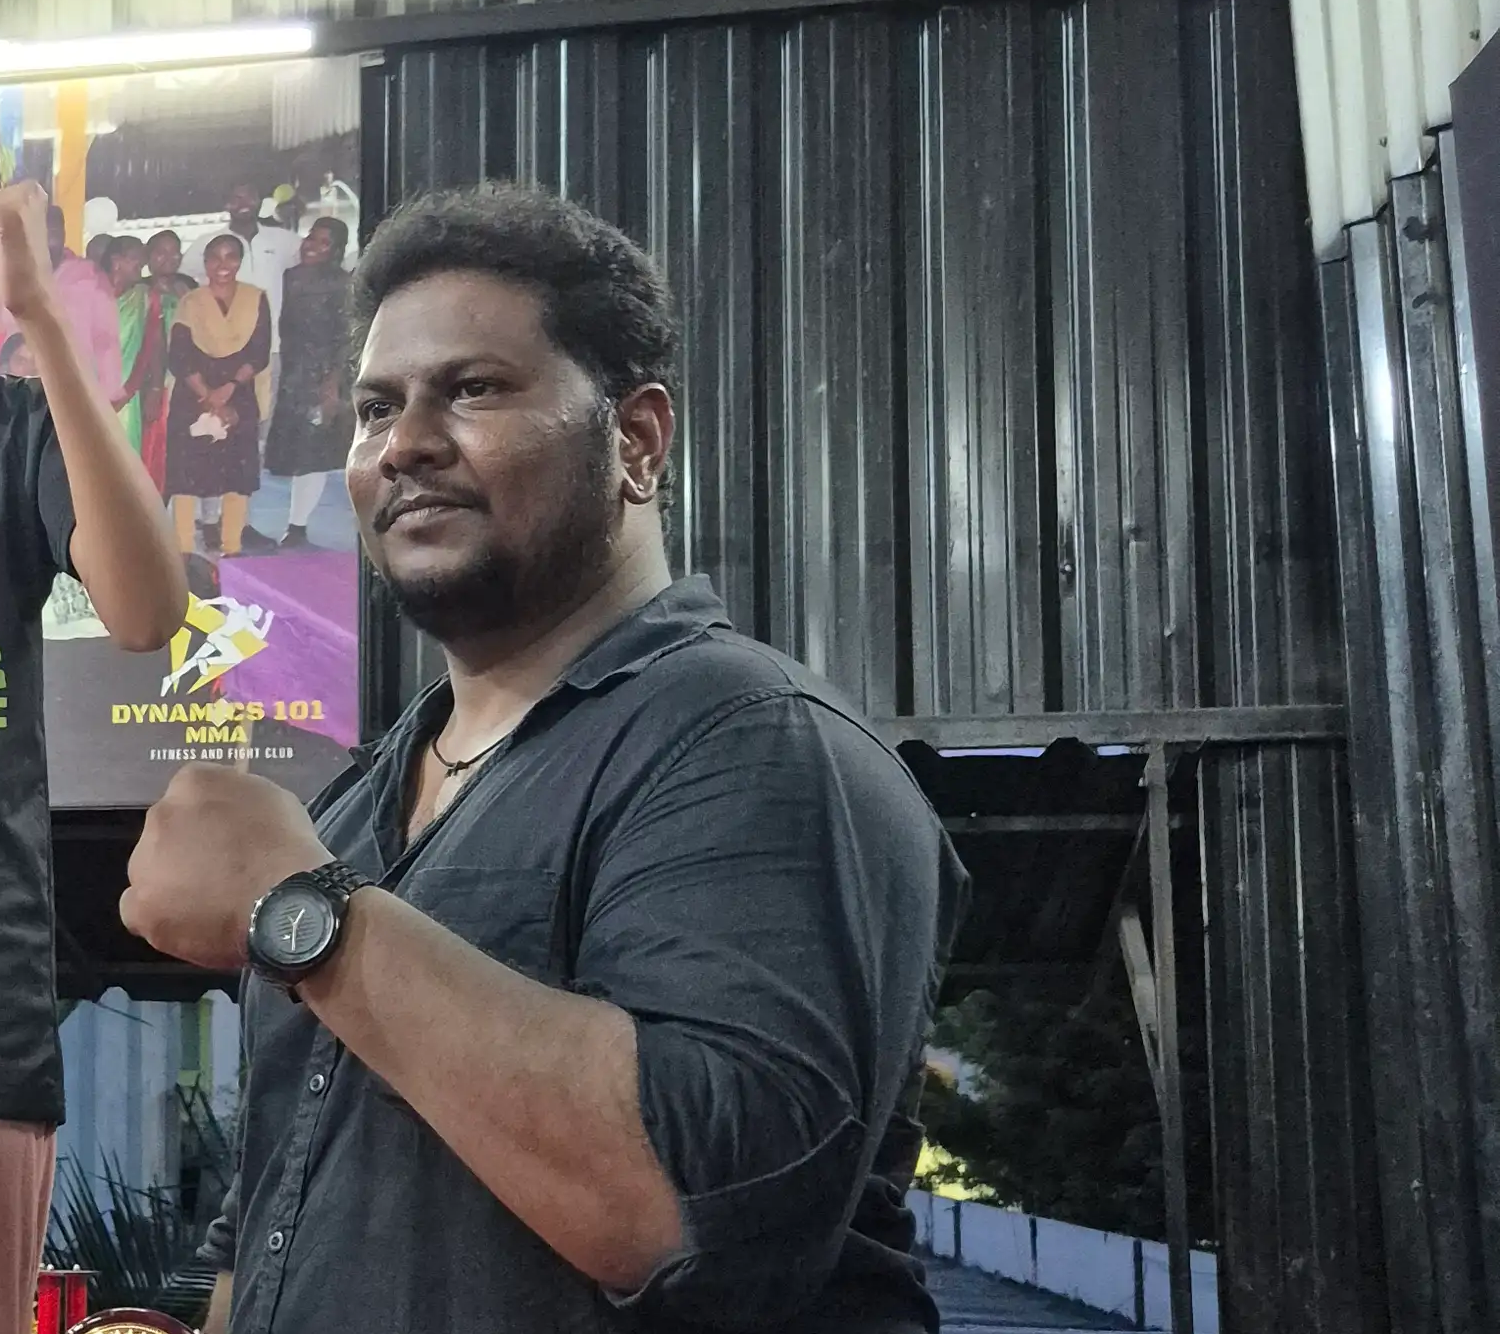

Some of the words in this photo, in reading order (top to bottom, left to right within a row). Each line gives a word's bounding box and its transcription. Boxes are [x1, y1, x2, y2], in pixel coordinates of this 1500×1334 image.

[273, 700, 325, 720] 101
[185, 726, 249, 744] MMA
[150, 748, 197, 760] FITNESS
[201, 748, 224, 760] AND
[228, 747, 260, 760] FIGHT
[265, 747, 294, 759] CLUB
